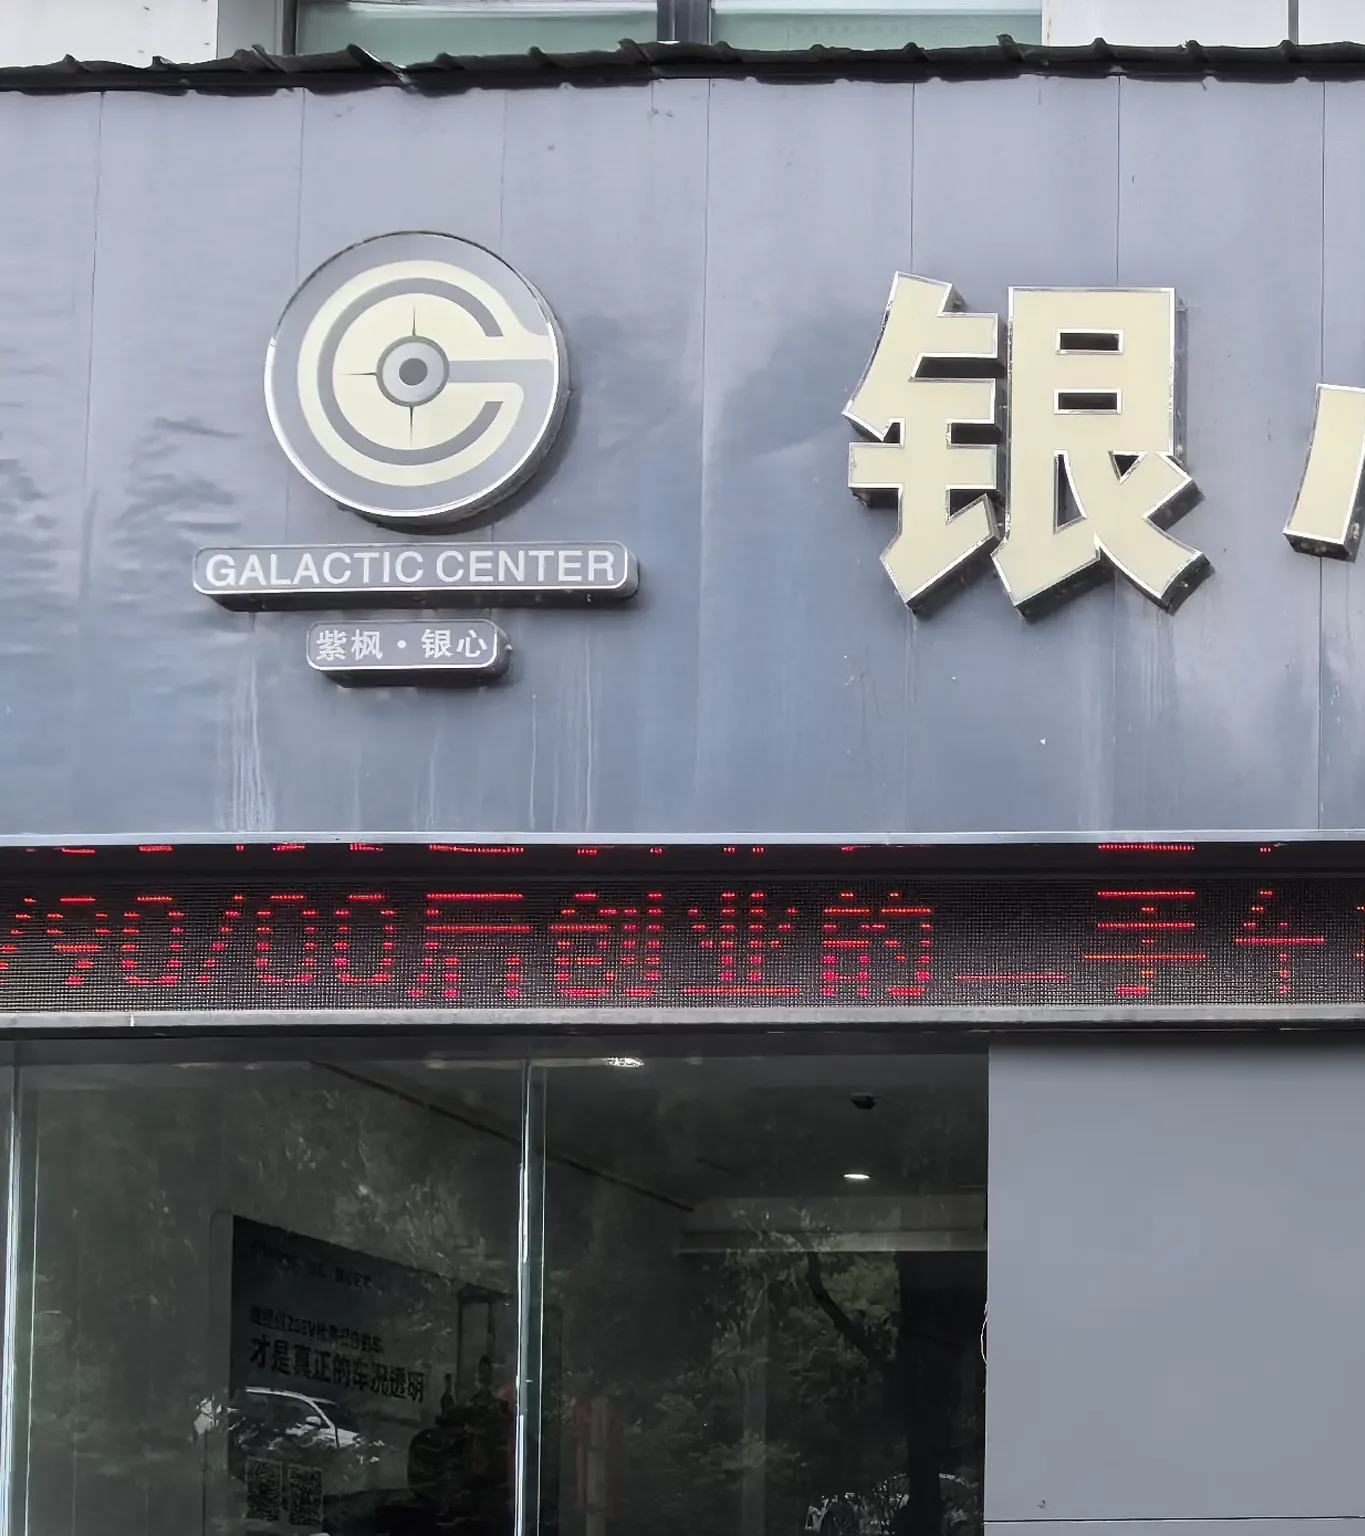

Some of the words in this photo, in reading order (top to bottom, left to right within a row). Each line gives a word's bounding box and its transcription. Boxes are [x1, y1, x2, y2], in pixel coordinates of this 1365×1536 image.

[205, 551, 424, 589] GALACTIC
[437, 549, 617, 584] CENTER
[316, 627, 489, 663] 紫枫·银心
